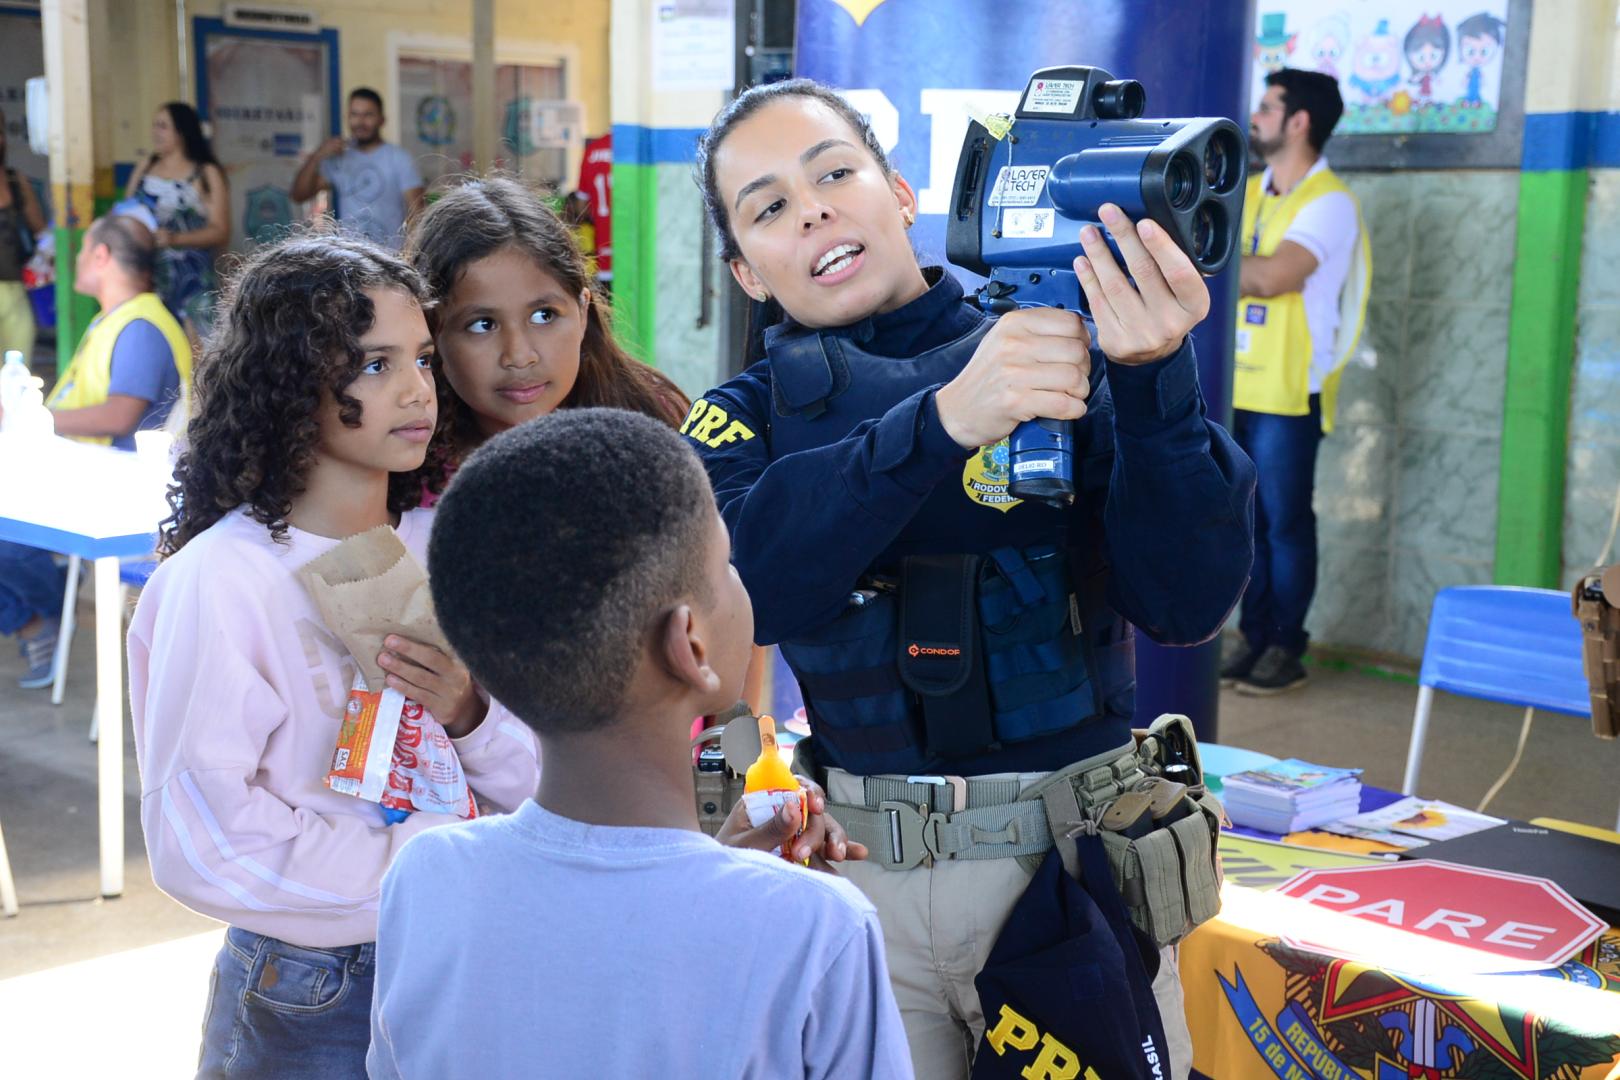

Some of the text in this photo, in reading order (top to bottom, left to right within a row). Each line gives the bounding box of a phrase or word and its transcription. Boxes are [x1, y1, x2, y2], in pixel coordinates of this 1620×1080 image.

[1011, 180, 1037, 191] TECH
[1012, 169, 1047, 180] LASER
[679, 399, 756, 448] PRF
[973, 482, 1009, 493] RODOV
[1301, 884, 1557, 950] PARE
[986, 1004, 1101, 1080] PR
[1249, 1018, 1271, 1043] 15
[1265, 1043, 1286, 1068] de
